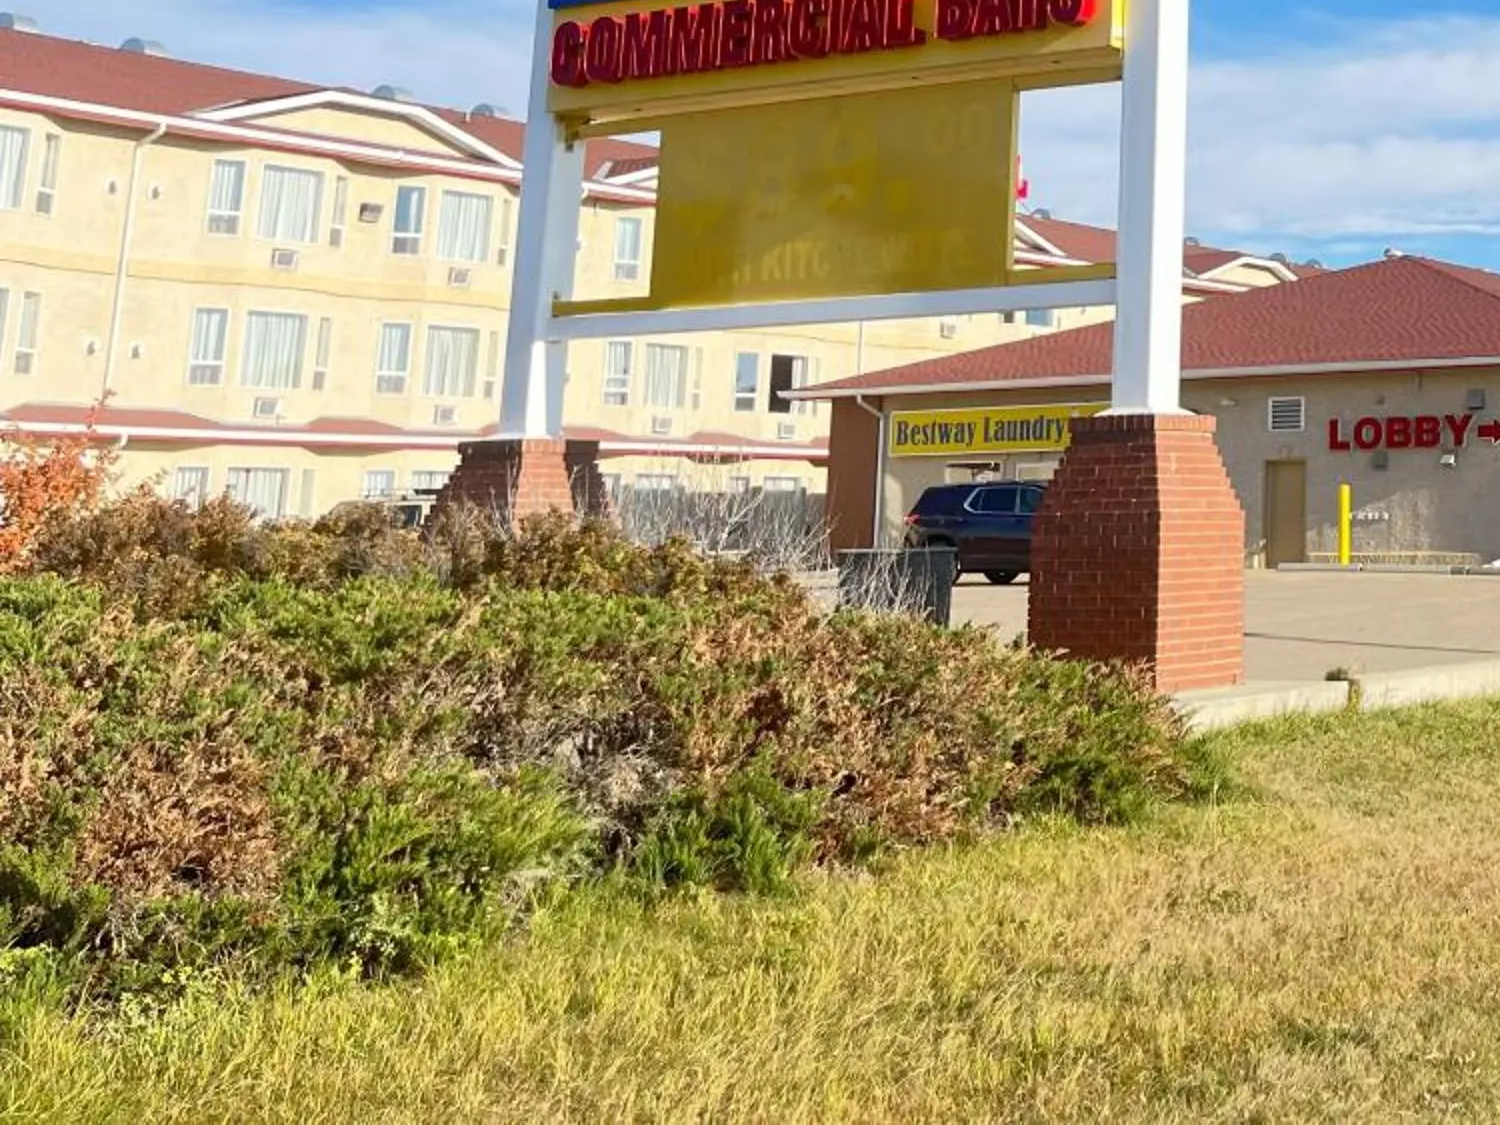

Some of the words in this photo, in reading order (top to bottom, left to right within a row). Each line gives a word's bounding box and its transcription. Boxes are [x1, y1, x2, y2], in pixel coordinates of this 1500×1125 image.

[895, 420, 976, 447] Bestway
[983, 415, 1065, 444] Laundry
[1328, 413, 1474, 451] LOBBY
